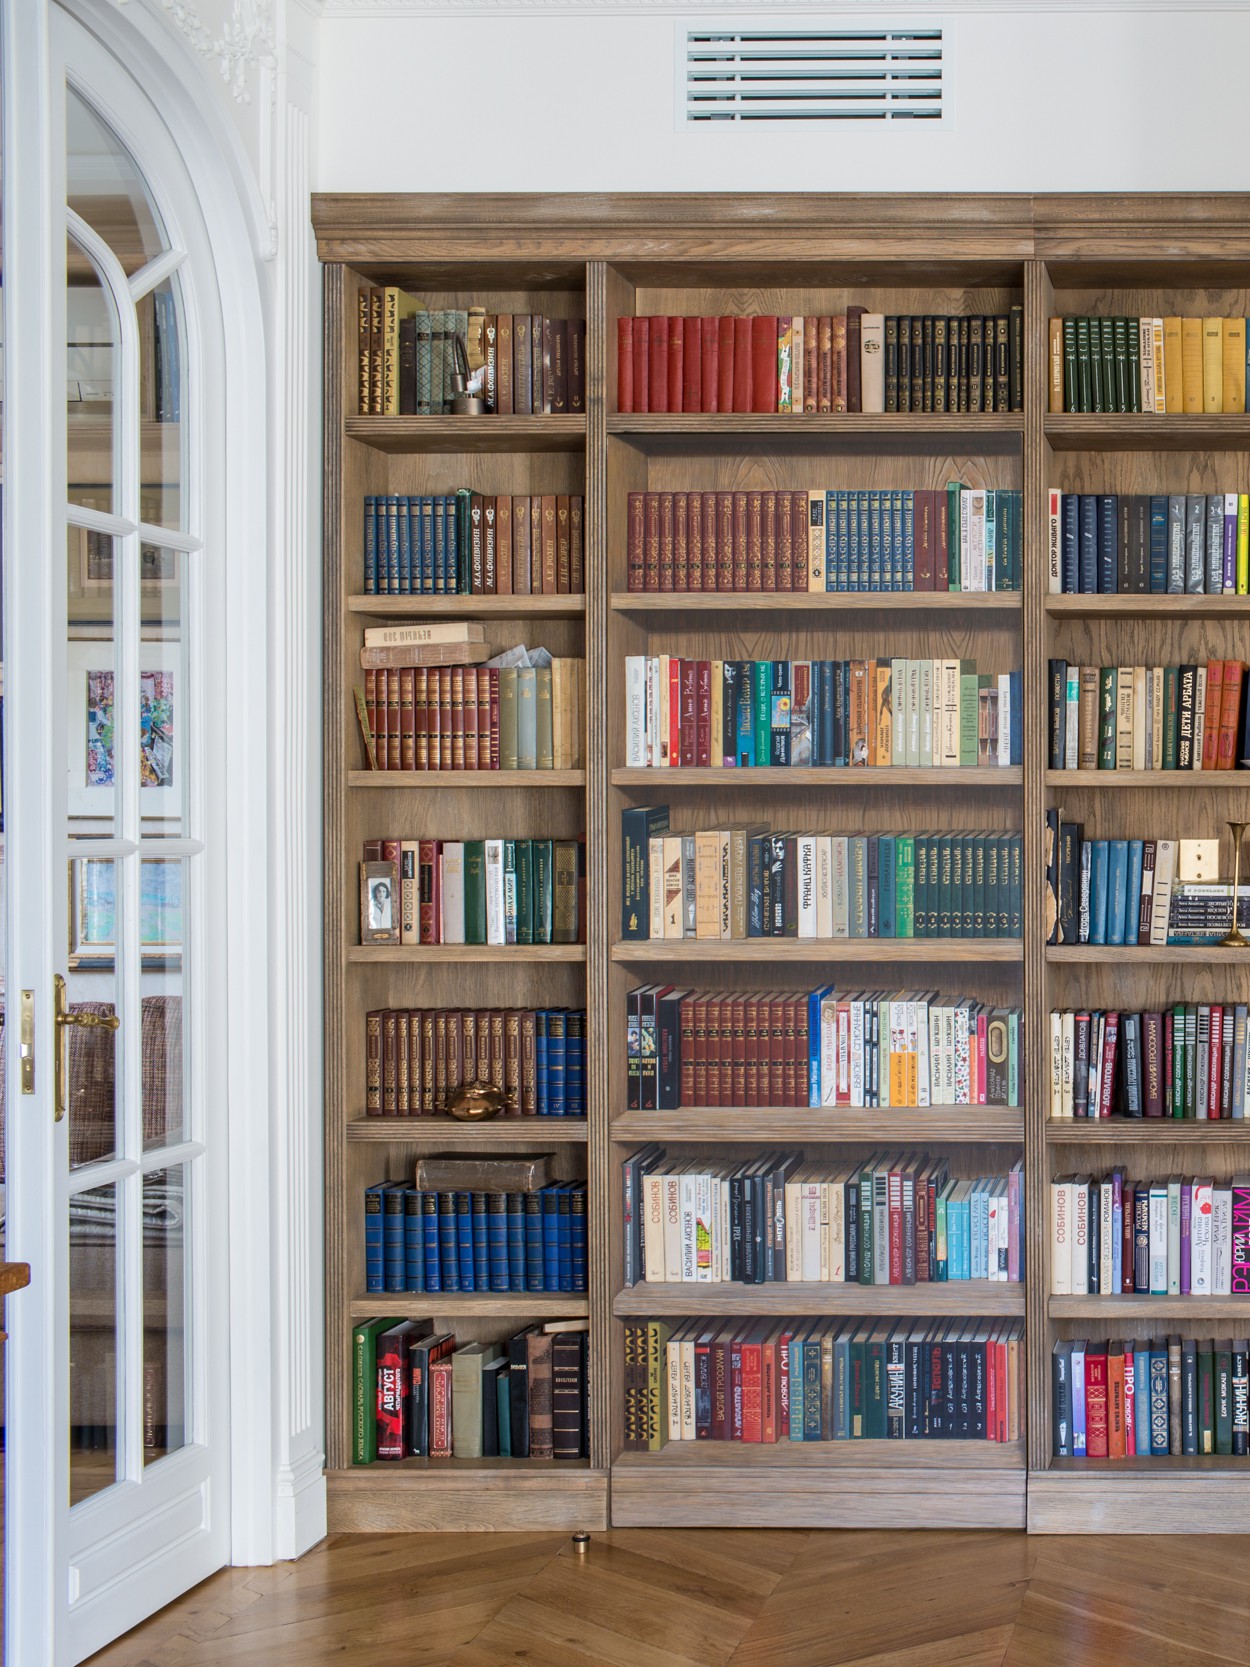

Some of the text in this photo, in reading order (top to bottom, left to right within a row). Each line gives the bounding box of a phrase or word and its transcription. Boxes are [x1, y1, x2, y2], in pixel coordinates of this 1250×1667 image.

[1181, 671, 1192, 737] ДЕТИ АРБАТА
[803, 844, 812, 909] ФРАНЦ КАФКА
[1080, 870, 1089, 935] Игорь Северянин
[1078, 1022, 1086, 1058] ДОВЛАТОВ
[1149, 1020, 1158, 1099] ВАСИЛИЙ ГРОССМАН
[651, 1181, 660, 1223] СОБИНОВ
[668, 1181, 677, 1224] СОБИНОВ
[1056, 1190, 1066, 1243] СОБИНОВ
[1077, 1192, 1086, 1245] СОБИНОВ
[683, 1243, 692, 1277] ВАСИЛИЙ
[1232, 1234, 1245, 1264] ЮРИЙ
[383, 1369, 394, 1410] АВГУСТ
[1235, 1384, 1246, 1424] АКУНИН
